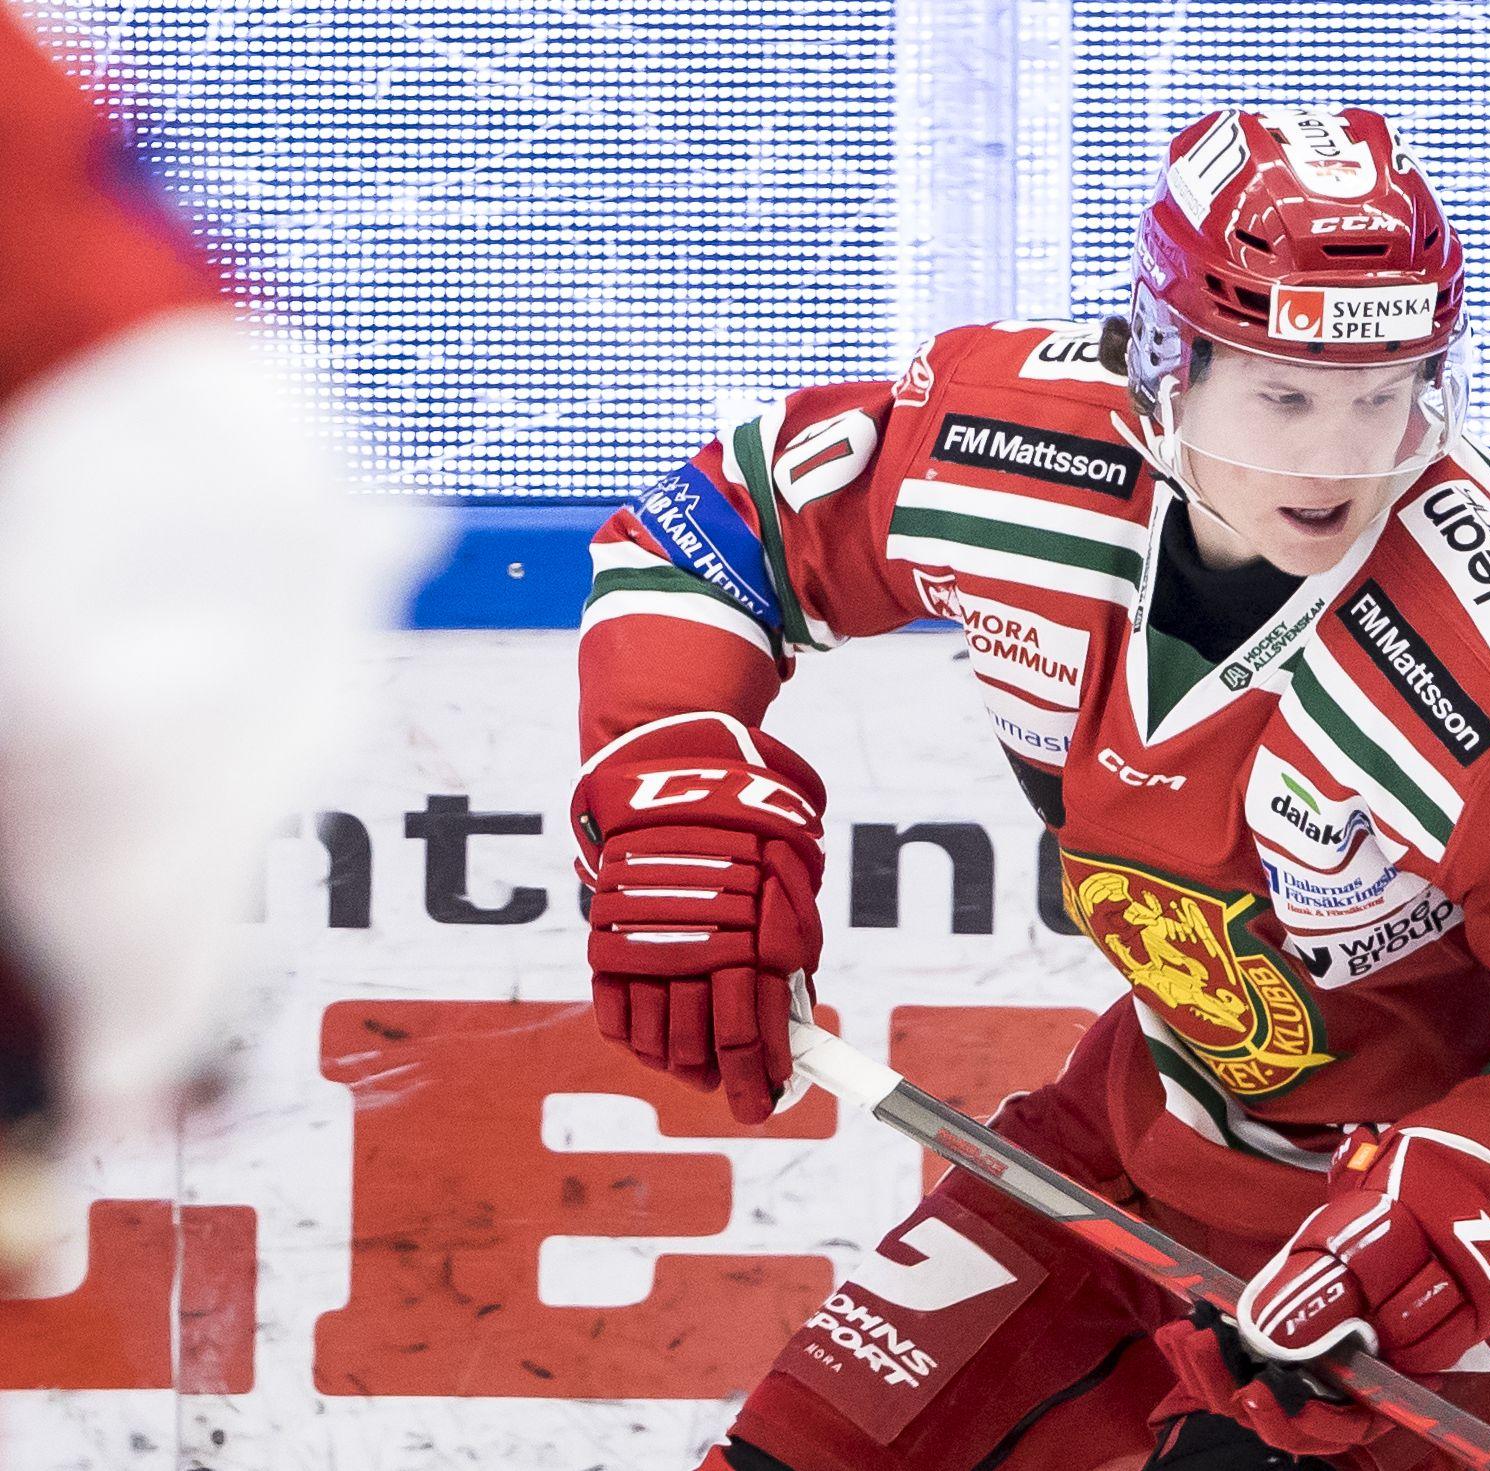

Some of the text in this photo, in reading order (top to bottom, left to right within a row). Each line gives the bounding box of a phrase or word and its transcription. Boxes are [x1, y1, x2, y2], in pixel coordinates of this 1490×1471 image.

[1310, 214, 1398, 235] CCM
[1332, 323, 1386, 339] SPEL
[1333, 298, 1431, 318] SVENSKA
[944, 424, 1128, 486] FM Mattsson
[657, 507, 703, 559] KARL
[960, 604, 1041, 649] MORA
[1243, 620, 1288, 664] HOCKEY
[1253, 598, 1326, 672] ALLSVENSKAN
[1350, 593, 1480, 751] FM Mattsson
[1097, 747, 1188, 791] CCM
[1284, 871, 1363, 896] Dalarnas
[1348, 899, 1454, 977] group
[1248, 966, 1305, 1055] KLUBB
[803, 1343, 843, 1373] MORA
[806, 1311, 920, 1389] PORT
[824, 1293, 938, 1377] OHNS
